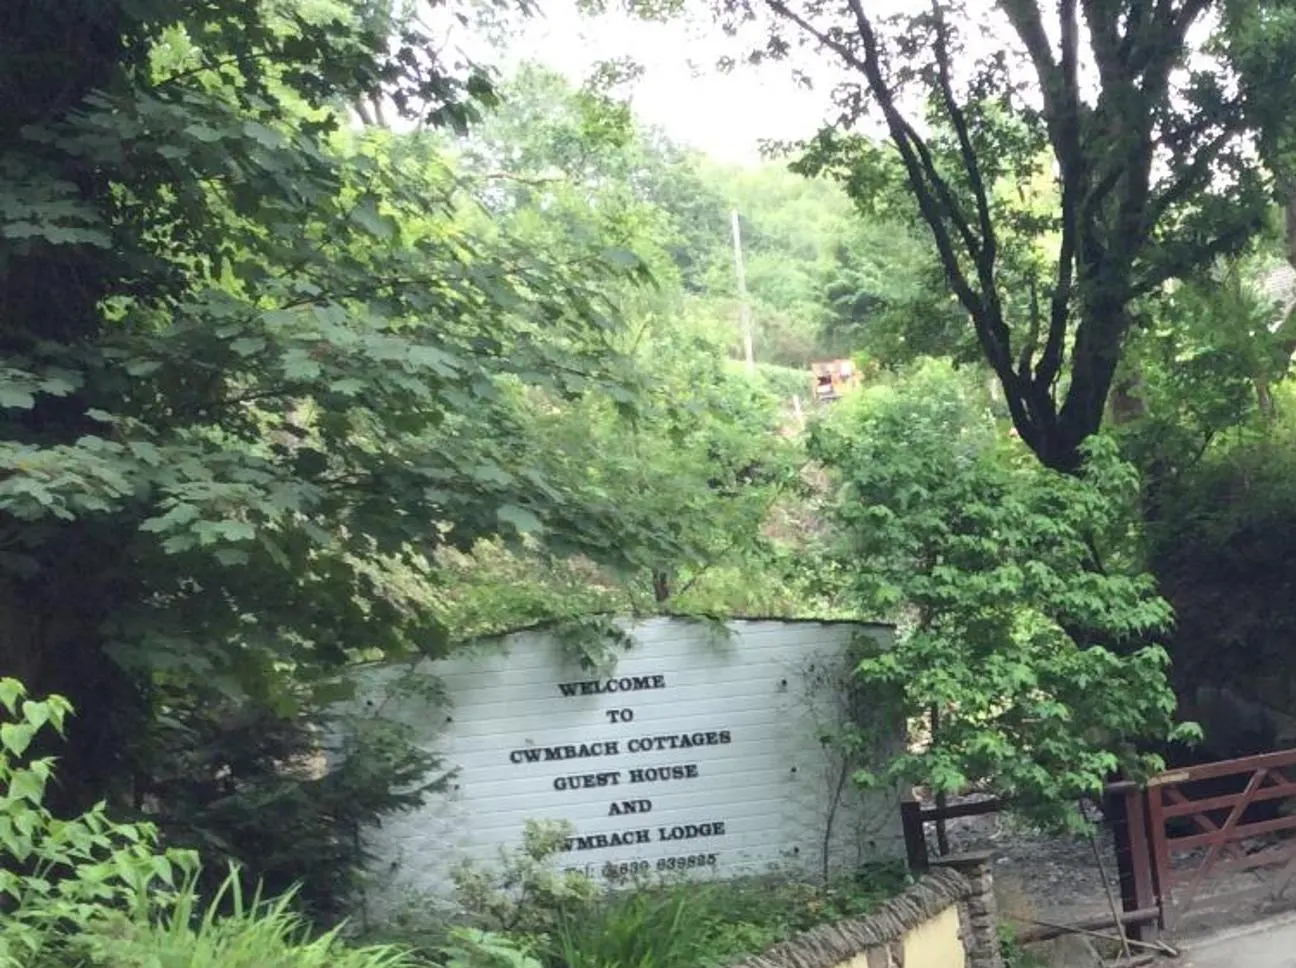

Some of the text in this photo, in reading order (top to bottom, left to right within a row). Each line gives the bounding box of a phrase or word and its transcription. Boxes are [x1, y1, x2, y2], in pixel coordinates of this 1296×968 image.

[558, 674, 666, 697] WELCOME
[606, 708, 634, 723] TO
[510, 730, 732, 764] CWMBACH COTTAGES
[553, 764, 699, 791] GUEST HOUSE
[608, 799, 652, 816] AND
[562, 821, 726, 851] WMBACH LODGE
